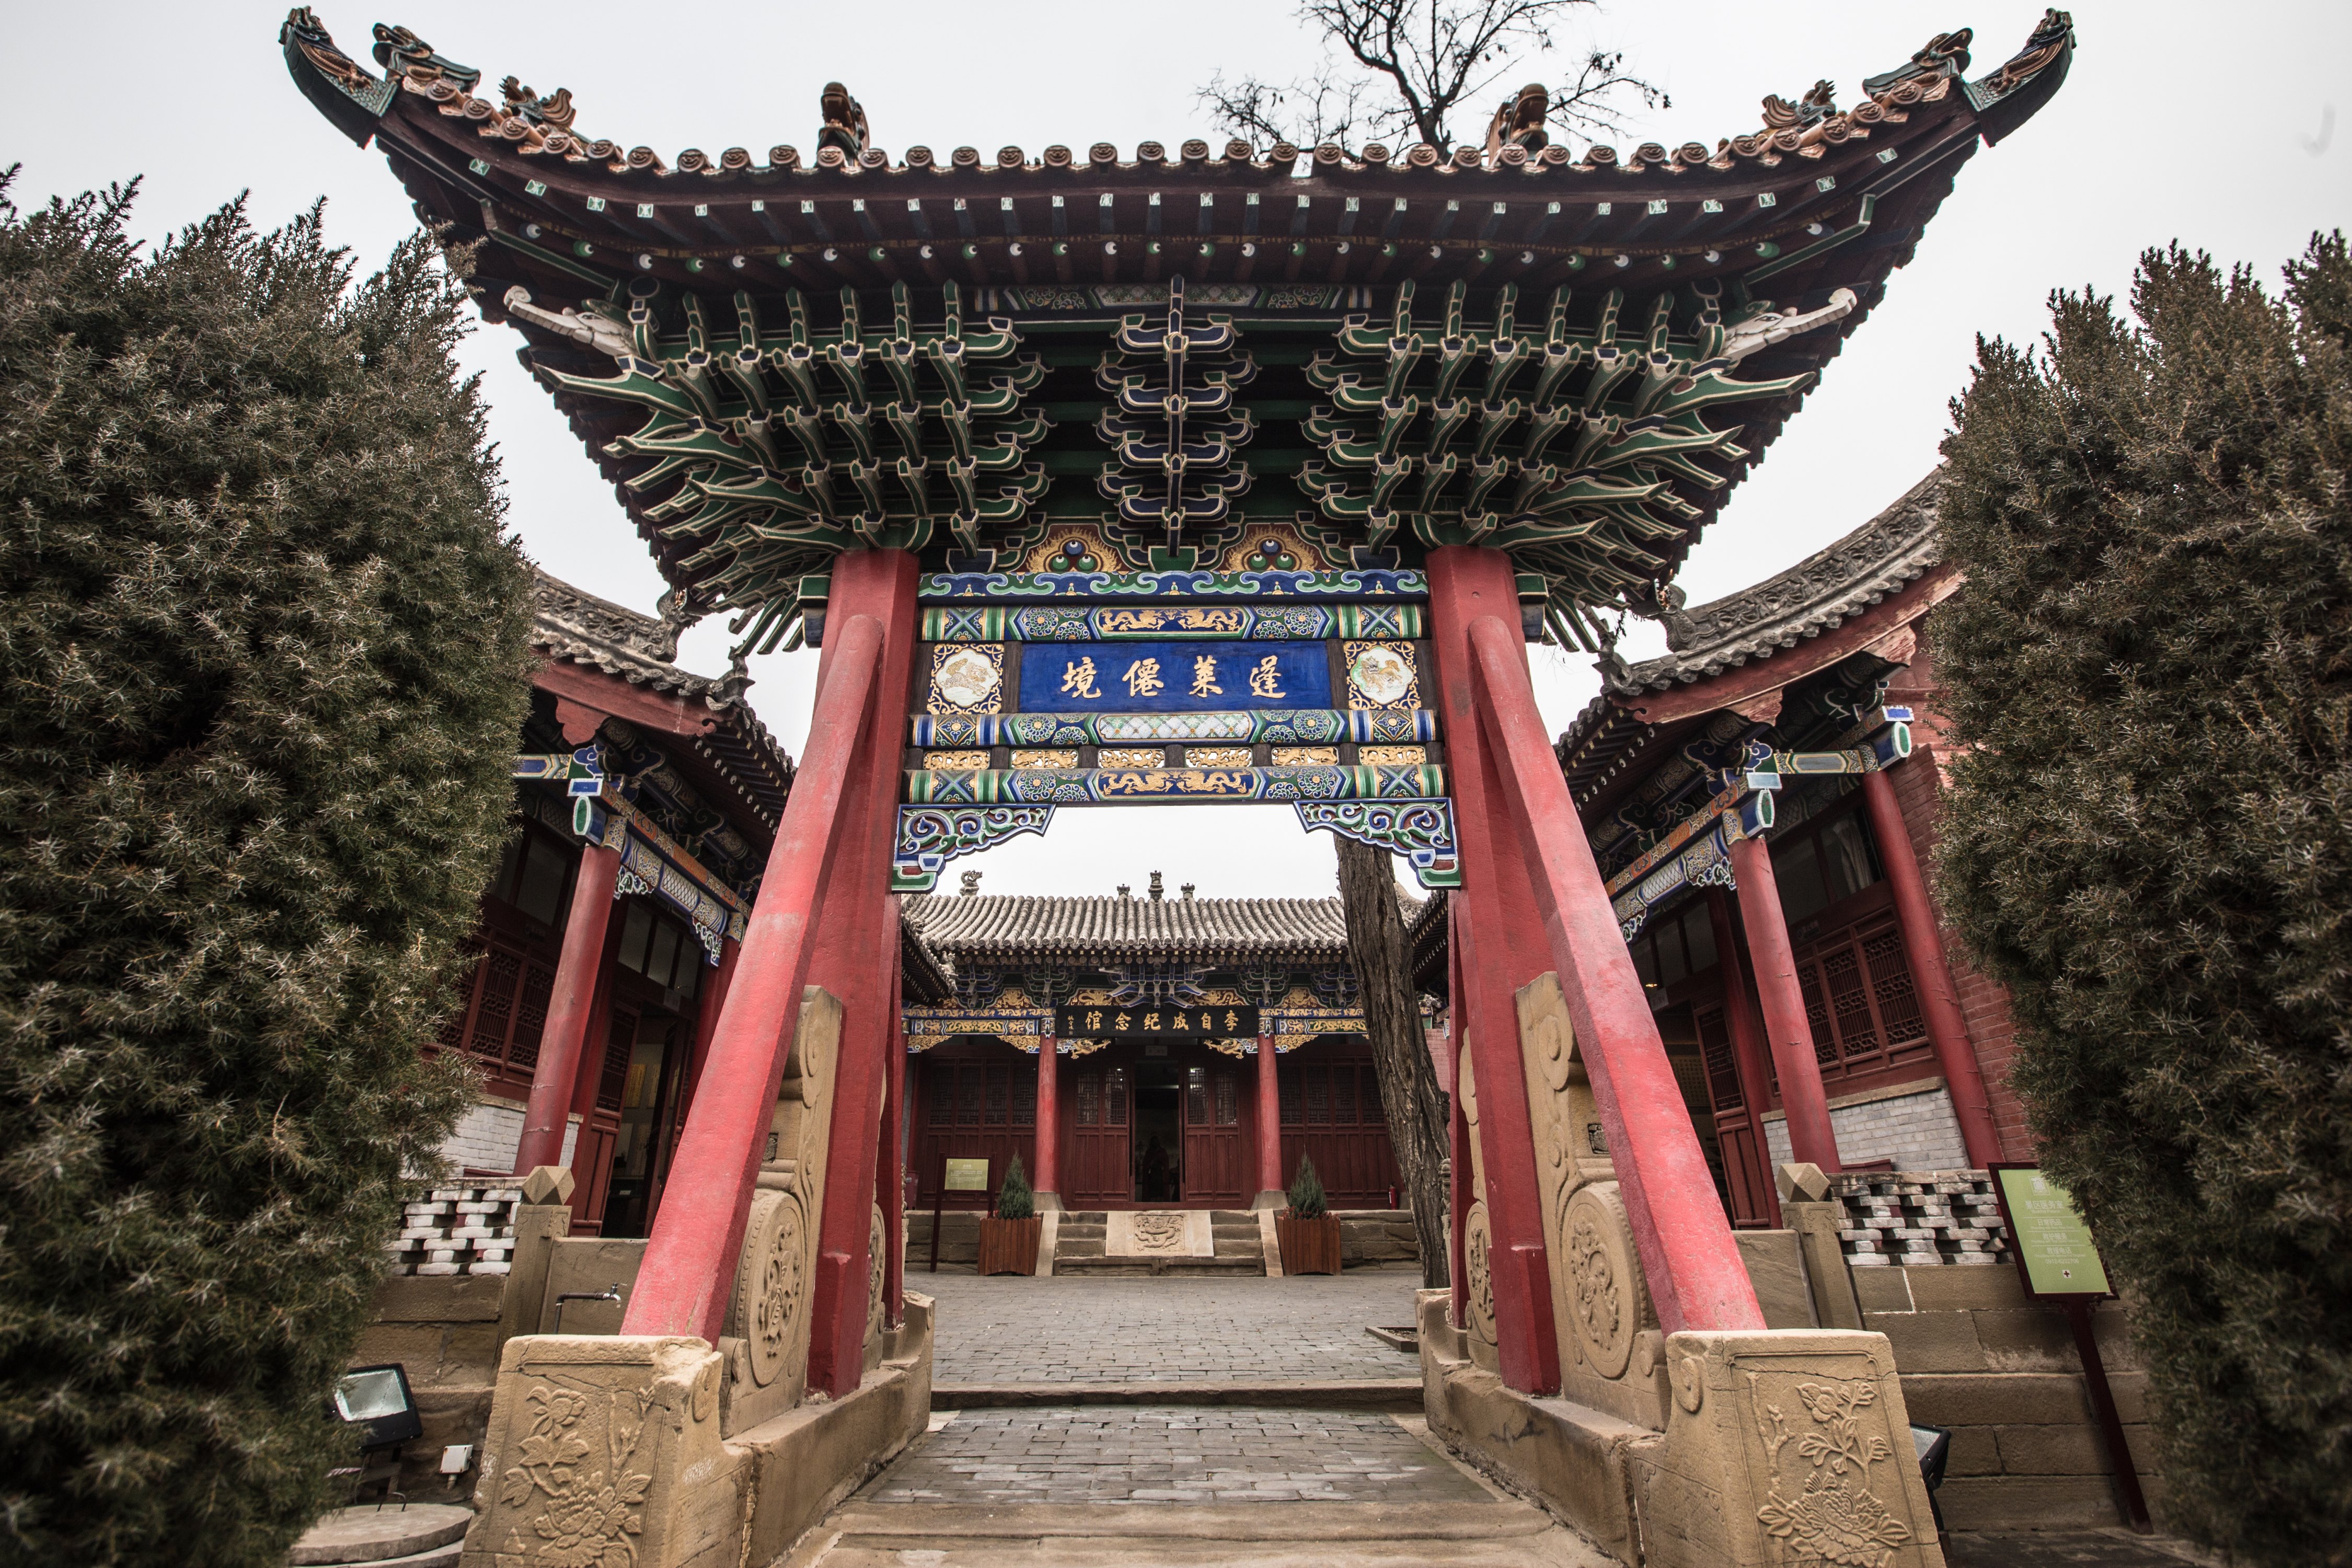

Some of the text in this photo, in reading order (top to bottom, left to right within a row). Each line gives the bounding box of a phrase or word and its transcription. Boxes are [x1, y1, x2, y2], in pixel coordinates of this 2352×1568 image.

[1085, 1010, 1239, 1032] 李自成纪念馆
[2025, 1200, 2065, 1209] 景区医务室
